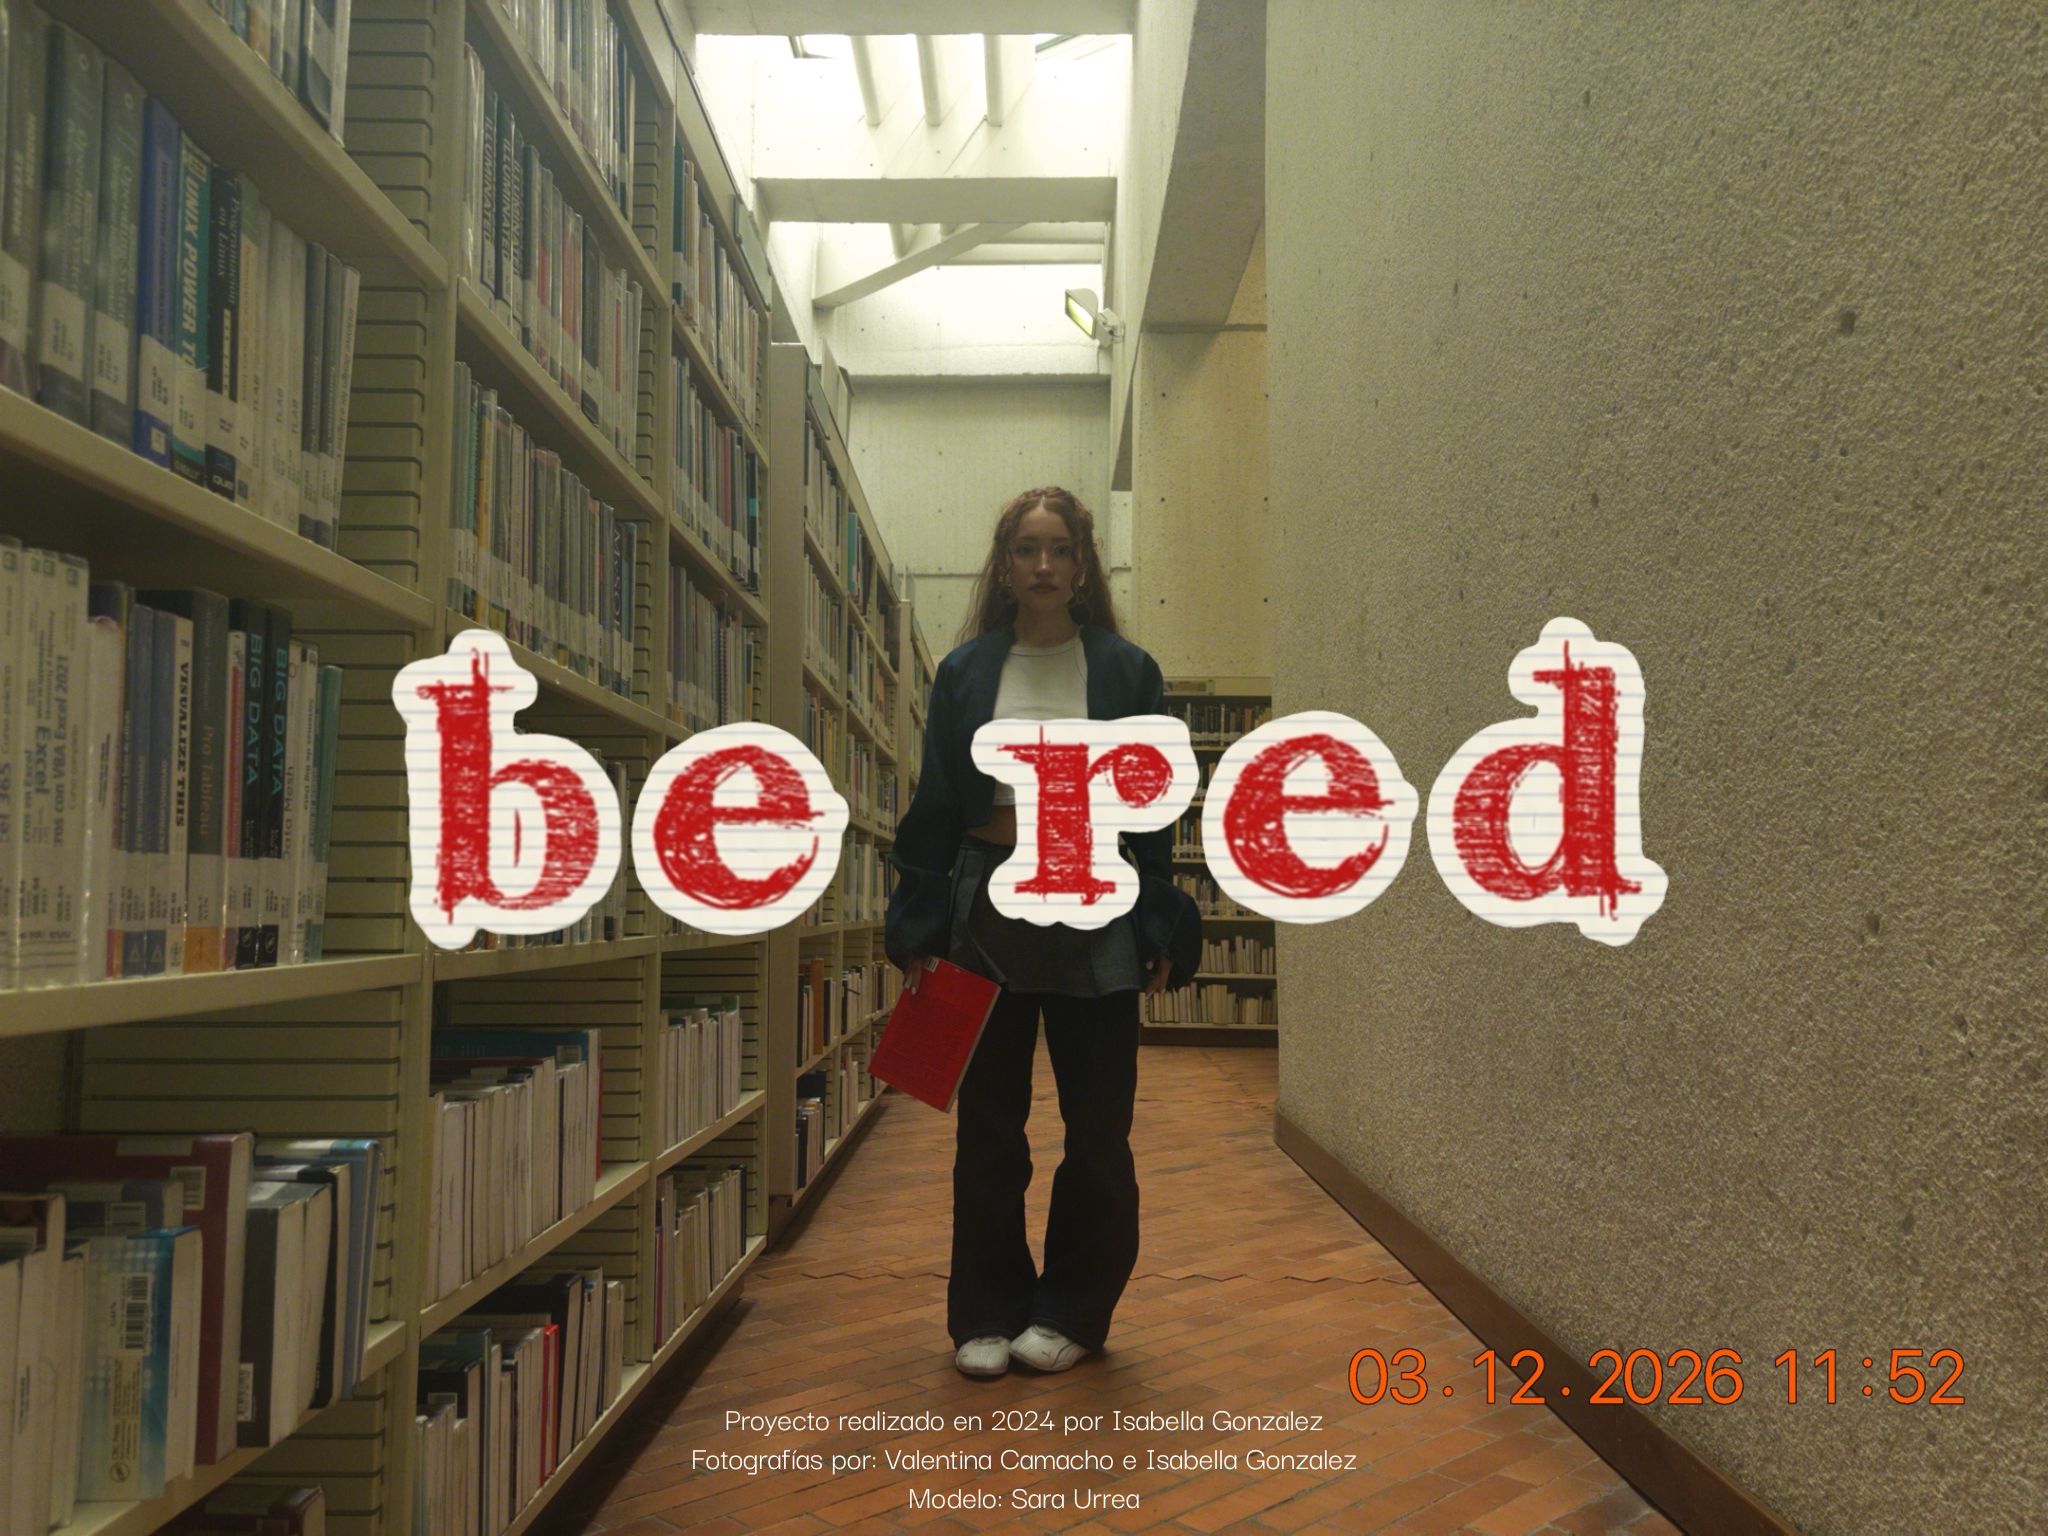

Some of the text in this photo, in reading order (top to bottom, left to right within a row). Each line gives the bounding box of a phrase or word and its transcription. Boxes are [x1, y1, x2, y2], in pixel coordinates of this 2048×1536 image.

[184, 176, 200, 239] UNIX
[483, 115, 495, 242] ILLUMINATED
[501, 138, 513, 260] ILLUMINATED
[216, 230, 229, 278] Linux
[182, 242, 199, 334] POWER
[56, 654, 70, 693] 2021
[54, 699, 68, 740] Excel
[200, 724, 215, 754] Pro
[246, 632, 263, 785] BIG DATA
[270, 647, 288, 796] BIG DATA
[35, 725, 51, 796] Excel
[54, 746, 67, 778] VBA
[175, 662, 190, 828] VISUALIZE THIS
[54, 784, 66, 813] con
[199, 765, 214, 837] Tableau
[283, 766, 295, 812] Mesh
